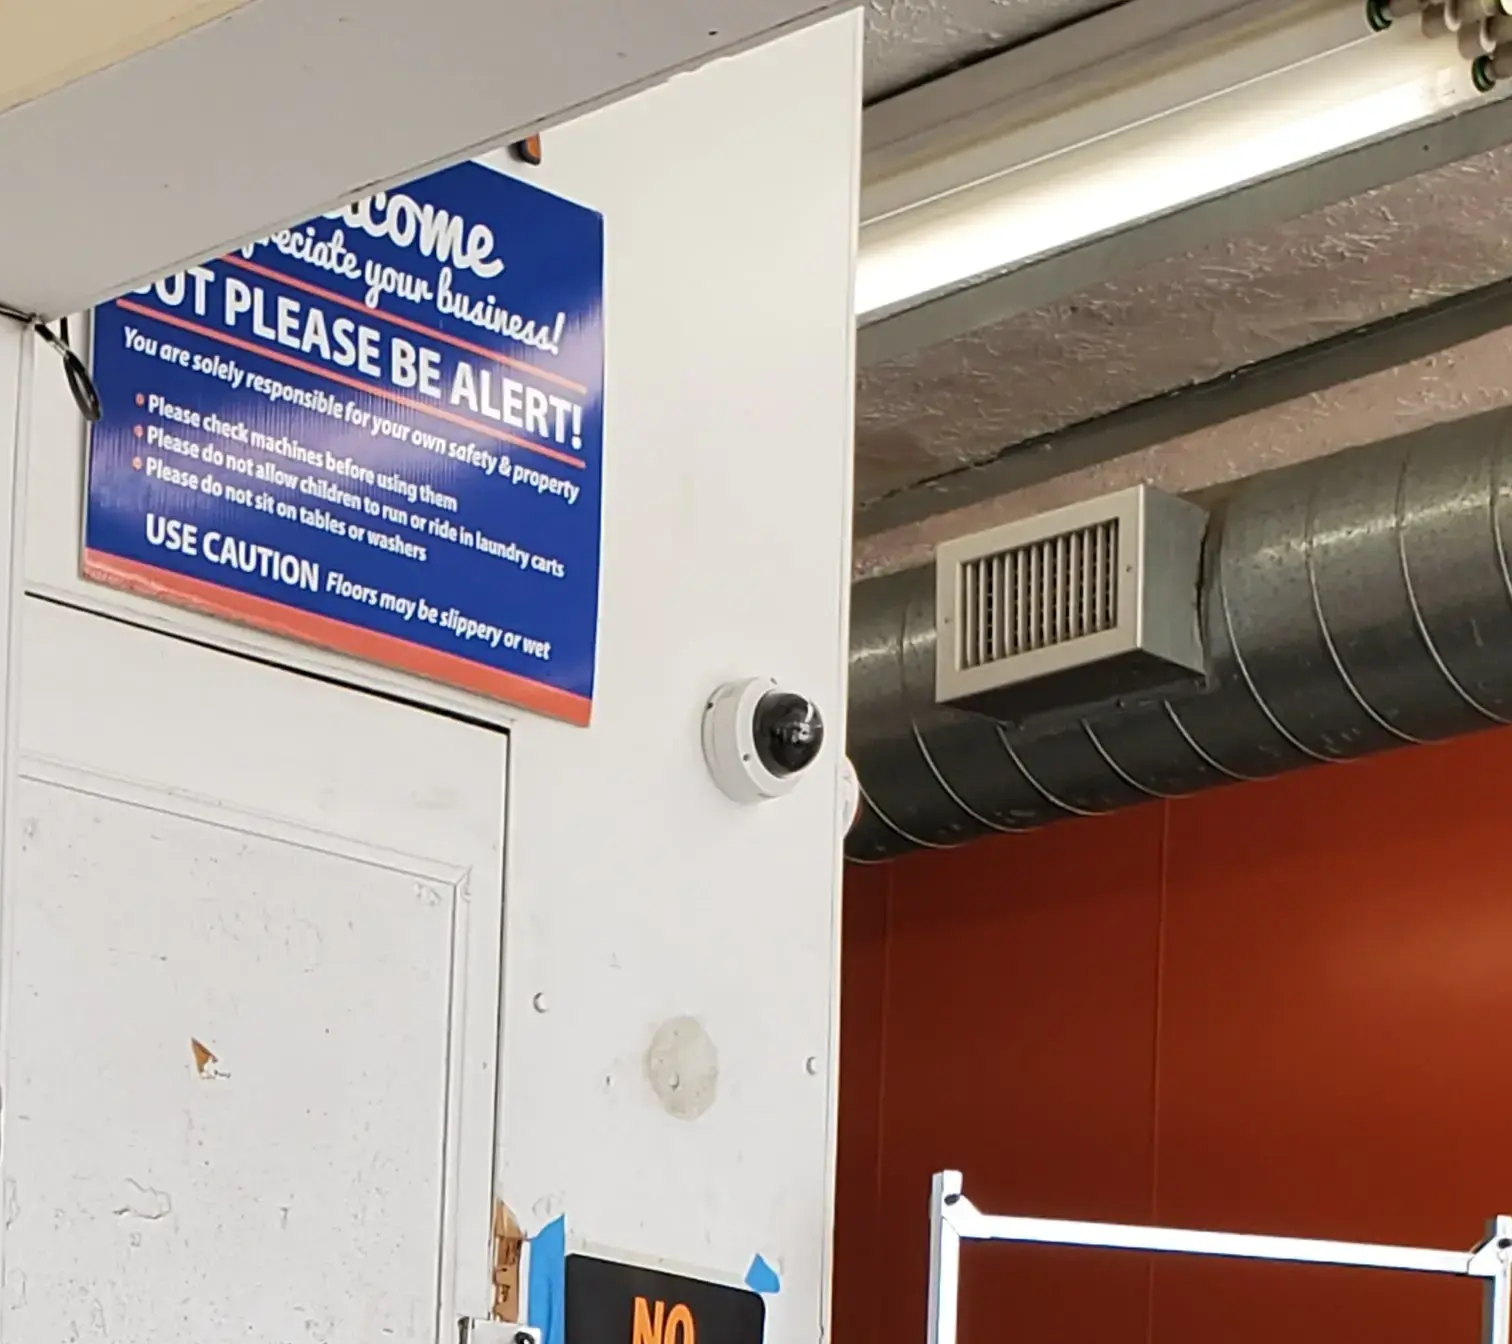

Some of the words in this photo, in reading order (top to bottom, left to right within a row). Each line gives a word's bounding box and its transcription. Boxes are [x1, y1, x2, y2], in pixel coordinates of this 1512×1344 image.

[322, 192, 505, 278] come
[131, 265, 215, 317] UT
[225, 277, 381, 377] PLEASE
[391, 337, 441, 399] BE
[450, 362, 582, 450] ALERT!
[365, 259, 433, 309] your
[437, 266, 566, 356] business!
[124, 326, 157, 356] You
[160, 343, 190, 366] are
[192, 355, 244, 389] solely
[246, 372, 343, 421] responsible
[345, 401, 371, 428] for
[371, 416, 410, 443] your
[411, 434, 446, 455] own
[448, 443, 498, 475] safety
[498, 456, 512, 476] &
[512, 463, 580, 504] property
[148, 394, 200, 428] Please
[203, 414, 248, 443] check
[251, 430, 323, 468] machines
[326, 451, 374, 485] before
[376, 471, 417, 503] using
[419, 484, 458, 512] them
[146, 457, 198, 490] Please
[200, 475, 222, 498] do
[225, 486, 252, 507] not
[255, 493, 275, 514] sit
[277, 502, 296, 521] on
[299, 507, 345, 537] tables
[348, 523, 365, 541] or
[367, 529, 428, 561] washers
[147, 425, 199, 459] Please
[201, 443, 223, 466] do
[226, 456, 253, 476] not
[255, 463, 297, 489] allow
[300, 477, 362, 511] children
[363, 496, 380, 516] to
[382, 506, 408, 526] run
[410, 515, 426, 532] or
[428, 517, 457, 542] ride
[460, 527, 474, 547] in
[476, 531, 530, 569] laundry
[531, 554, 565, 578] carts
[146, 513, 198, 556] USE
[203, 532, 319, 592] CAUTION
[326, 571, 378, 606] Floors
[380, 592, 416, 621] may
[417, 600, 438, 624] be
[440, 607, 503, 648] slippery
[503, 629, 521, 650] or
[522, 637, 552, 660] wet
